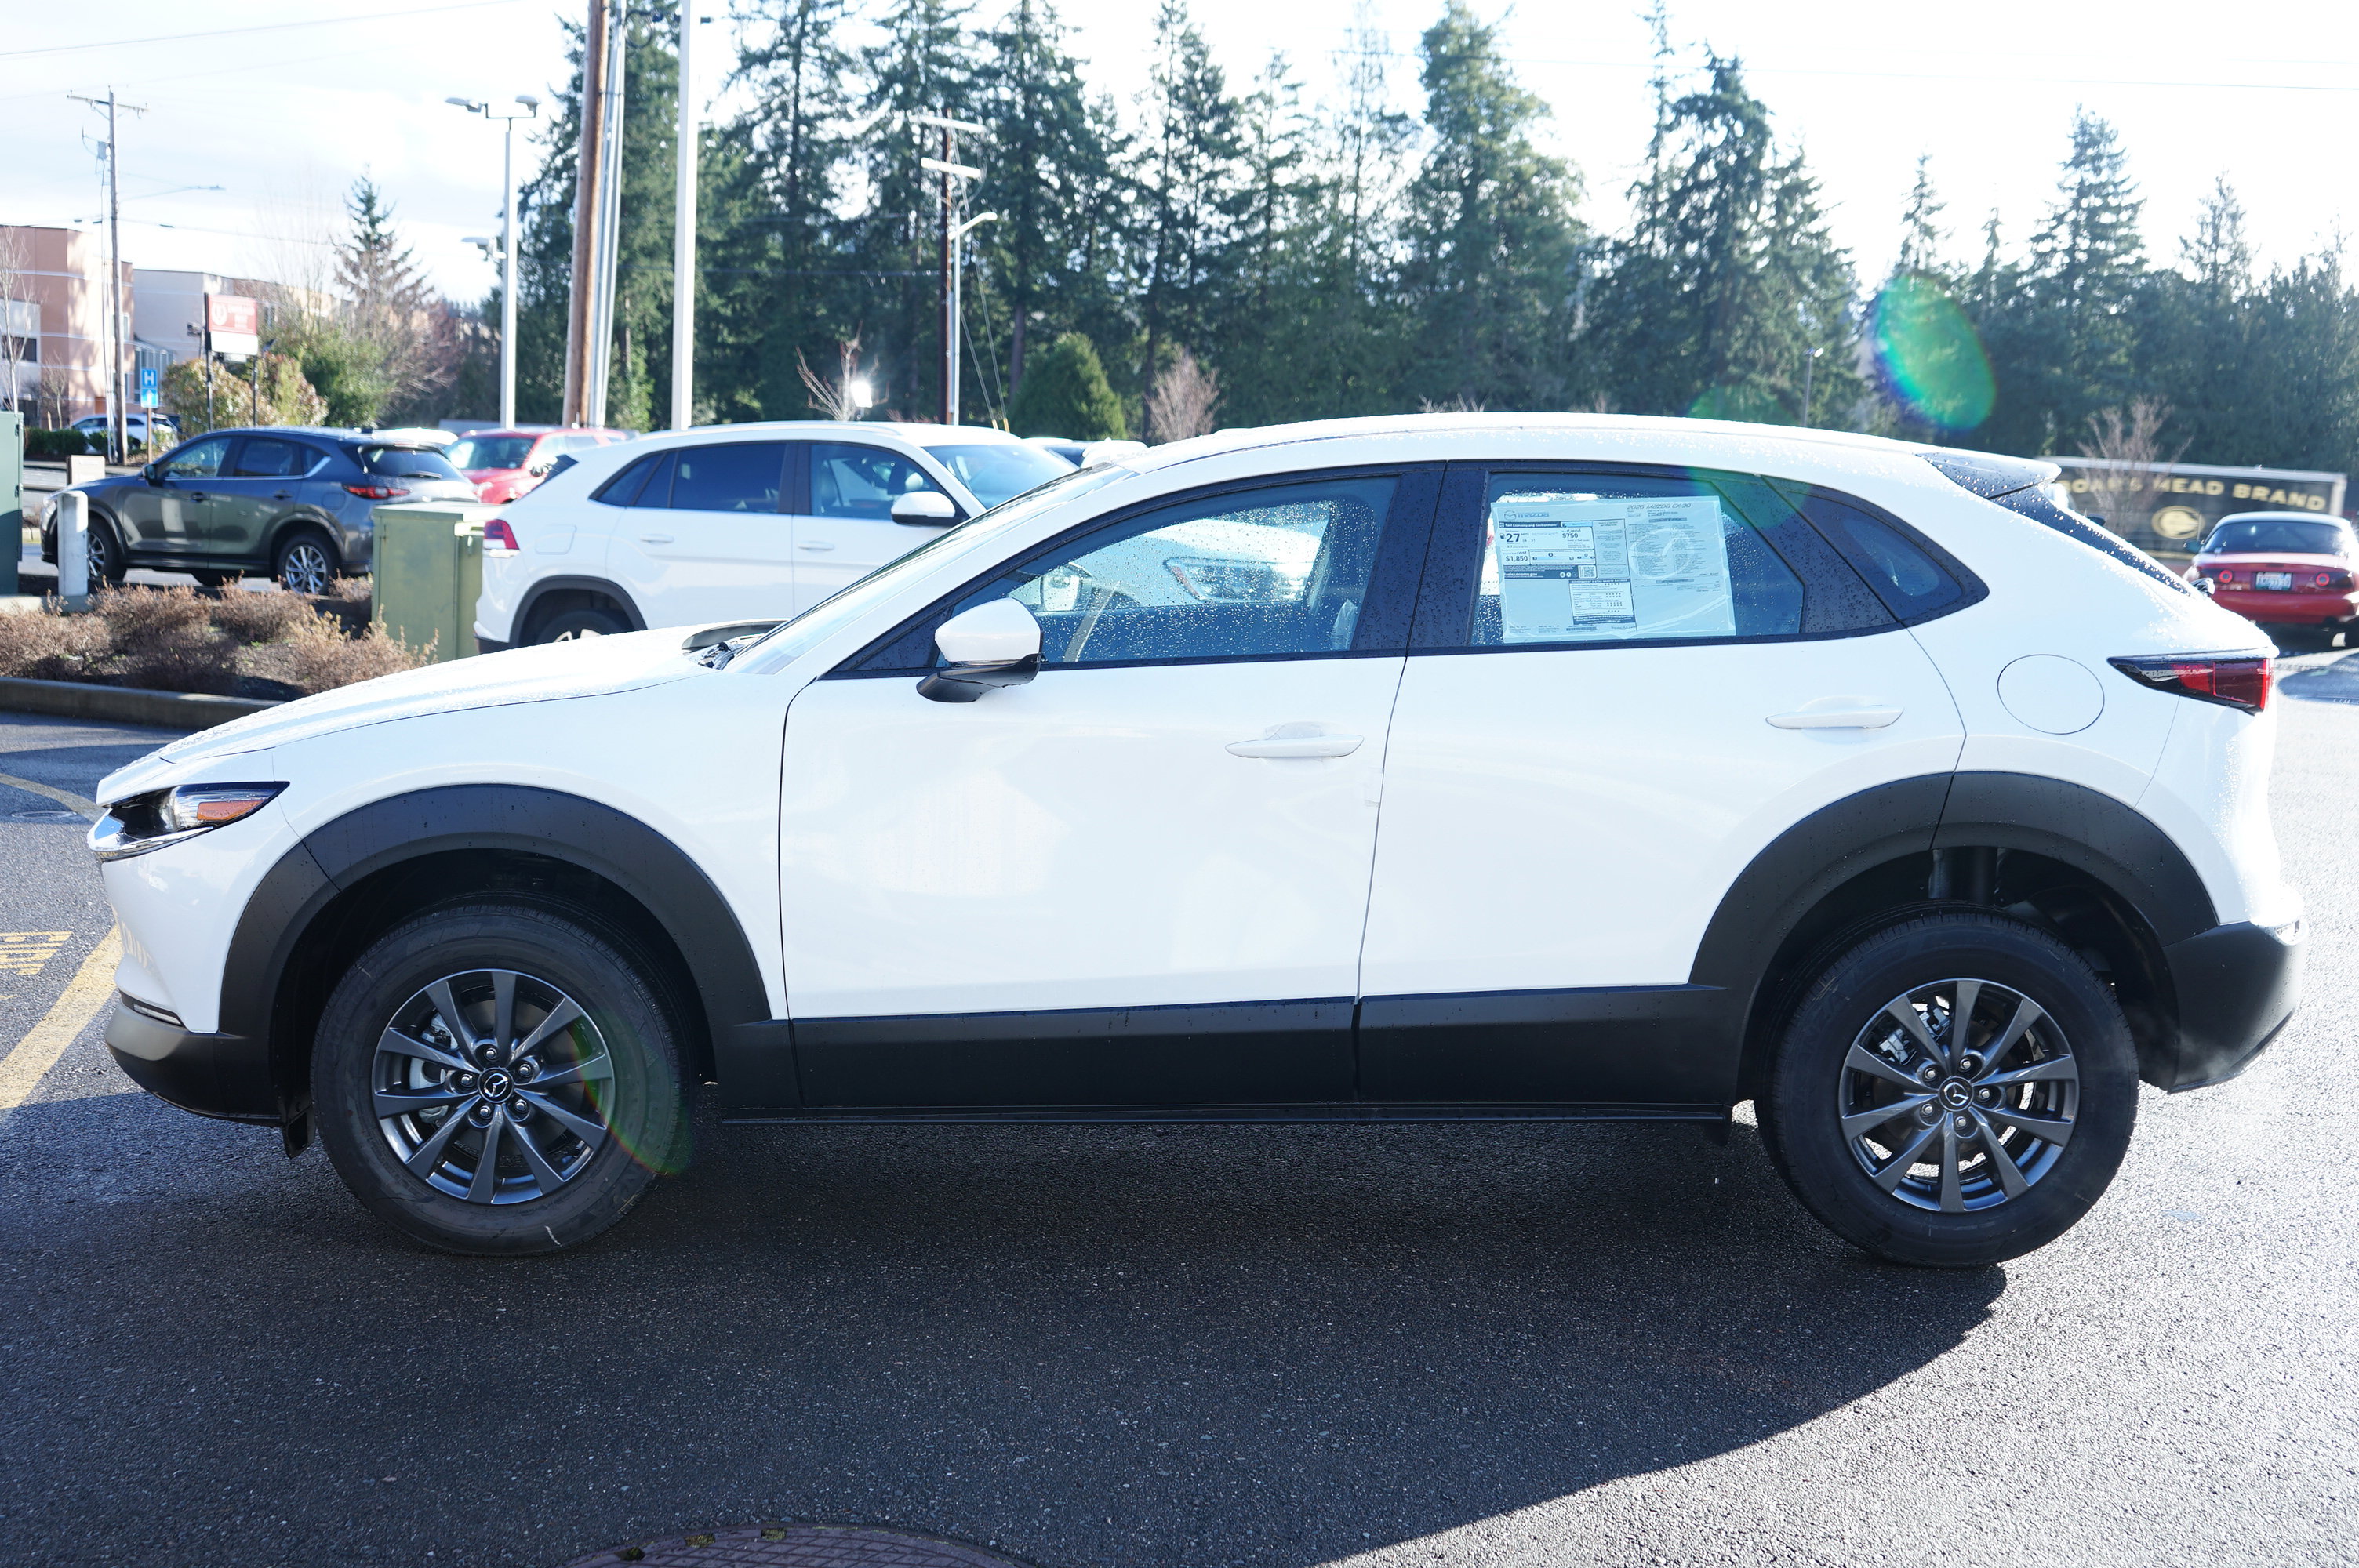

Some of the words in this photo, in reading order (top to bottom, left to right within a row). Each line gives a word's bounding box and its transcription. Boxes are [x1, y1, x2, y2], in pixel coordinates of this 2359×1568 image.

[144, 371, 154, 385] H
[2152, 477, 2225, 495] HEAD
[2232, 483, 2326, 510] BRAND
[1506, 532, 1521, 543] 27
